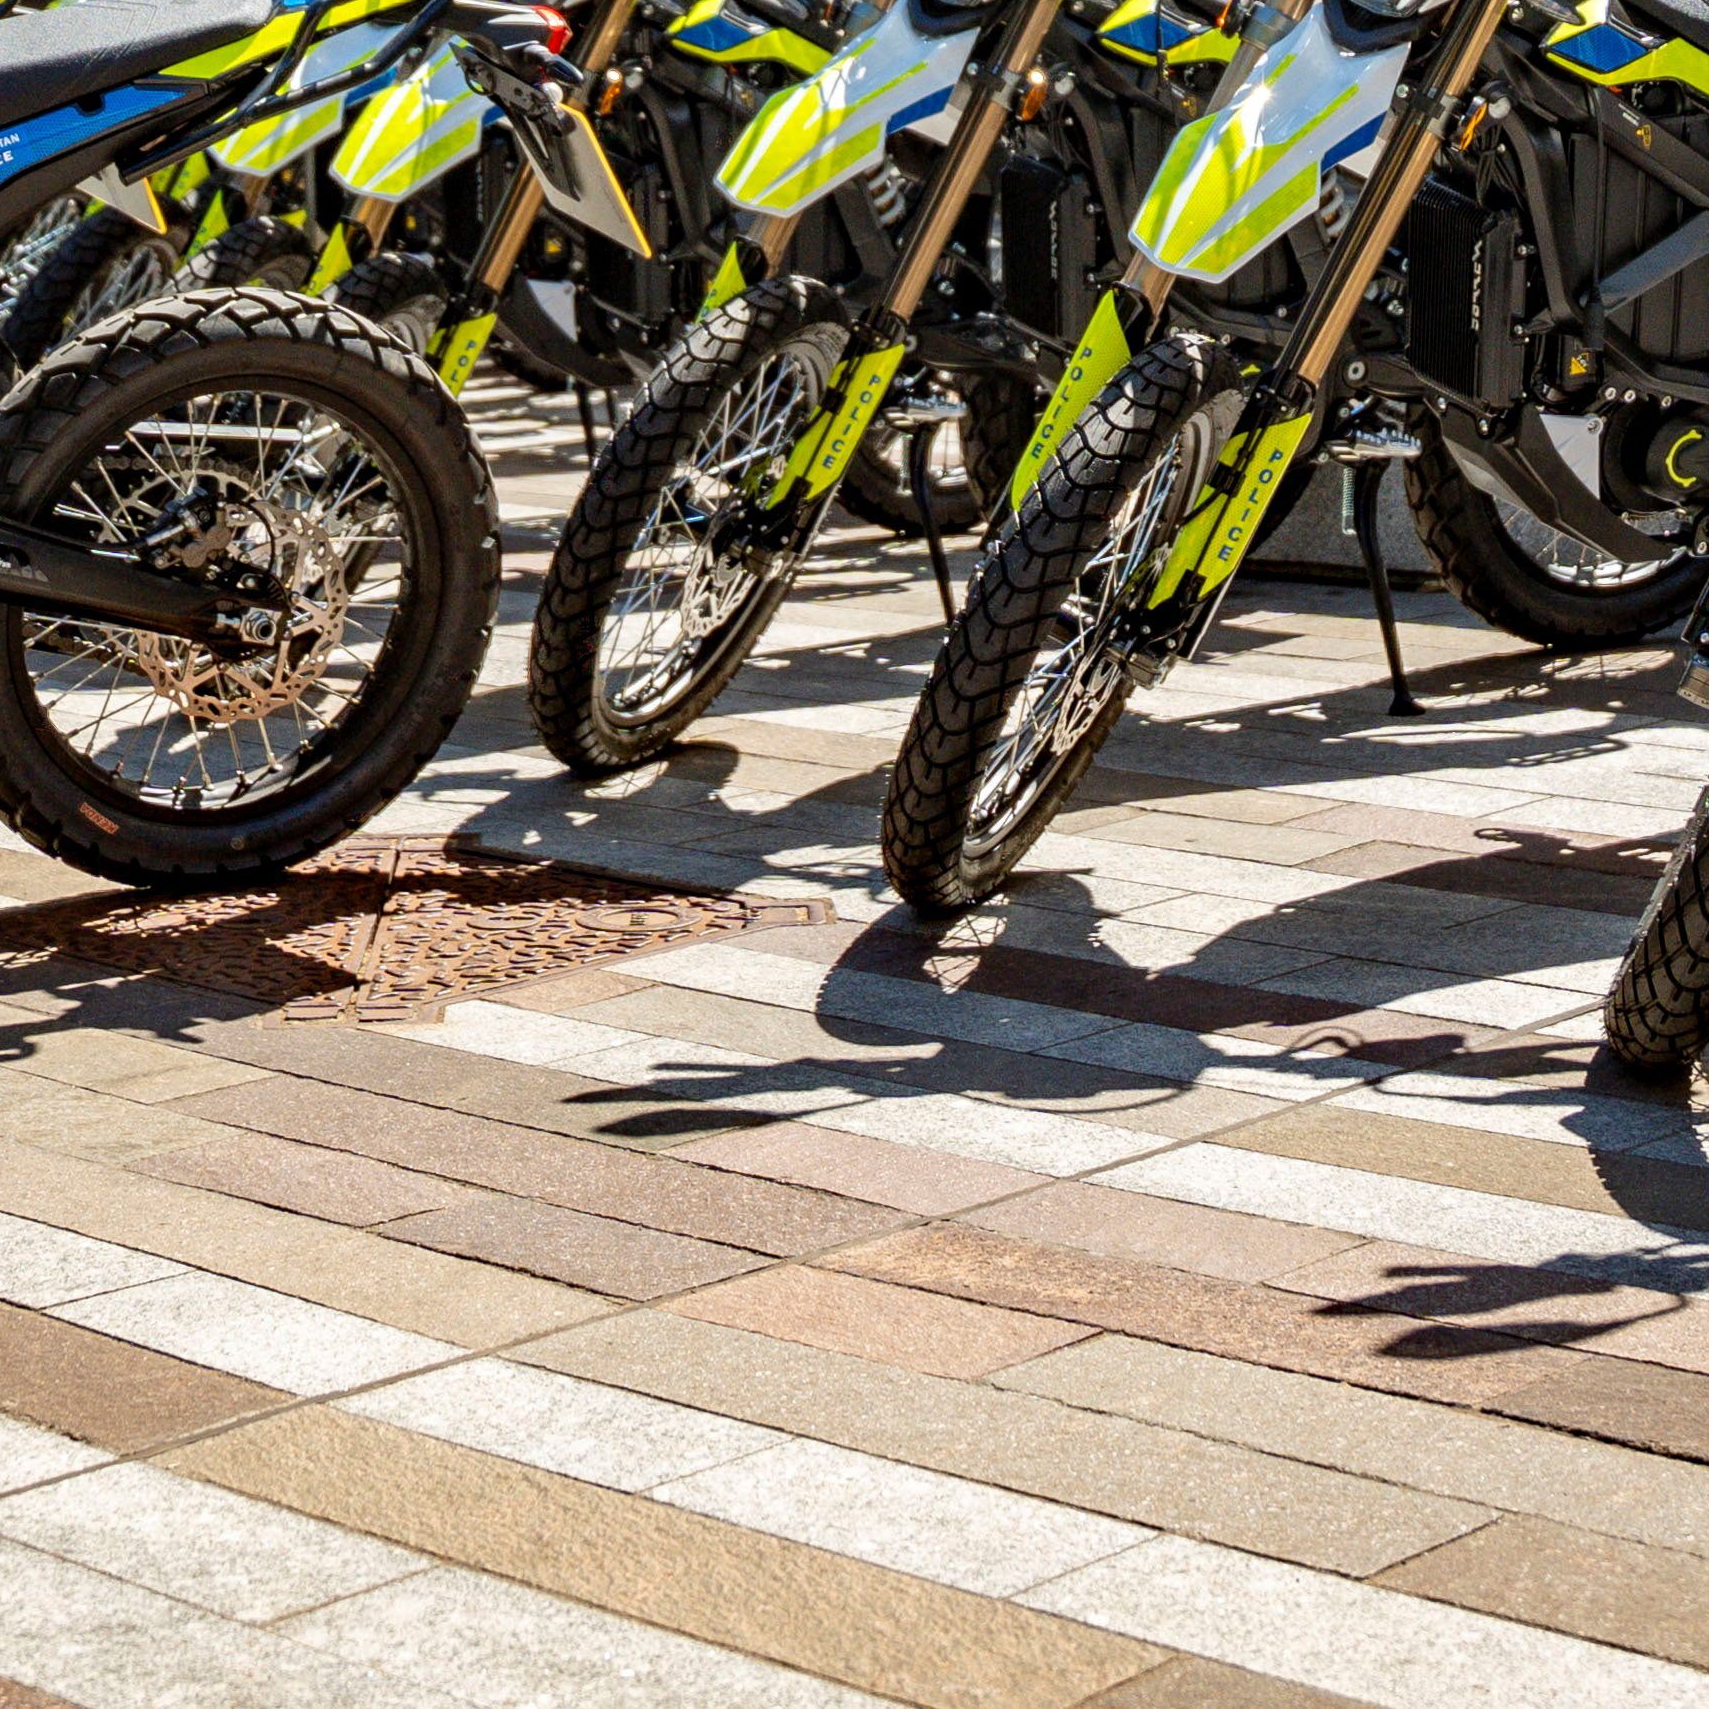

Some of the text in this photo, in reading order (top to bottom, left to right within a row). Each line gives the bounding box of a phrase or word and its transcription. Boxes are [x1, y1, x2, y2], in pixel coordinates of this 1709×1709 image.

[822, 374, 882, 469] POLICE
[1031, 346, 1093, 460] POLICE
[1217, 448, 1284, 562] POLICE
